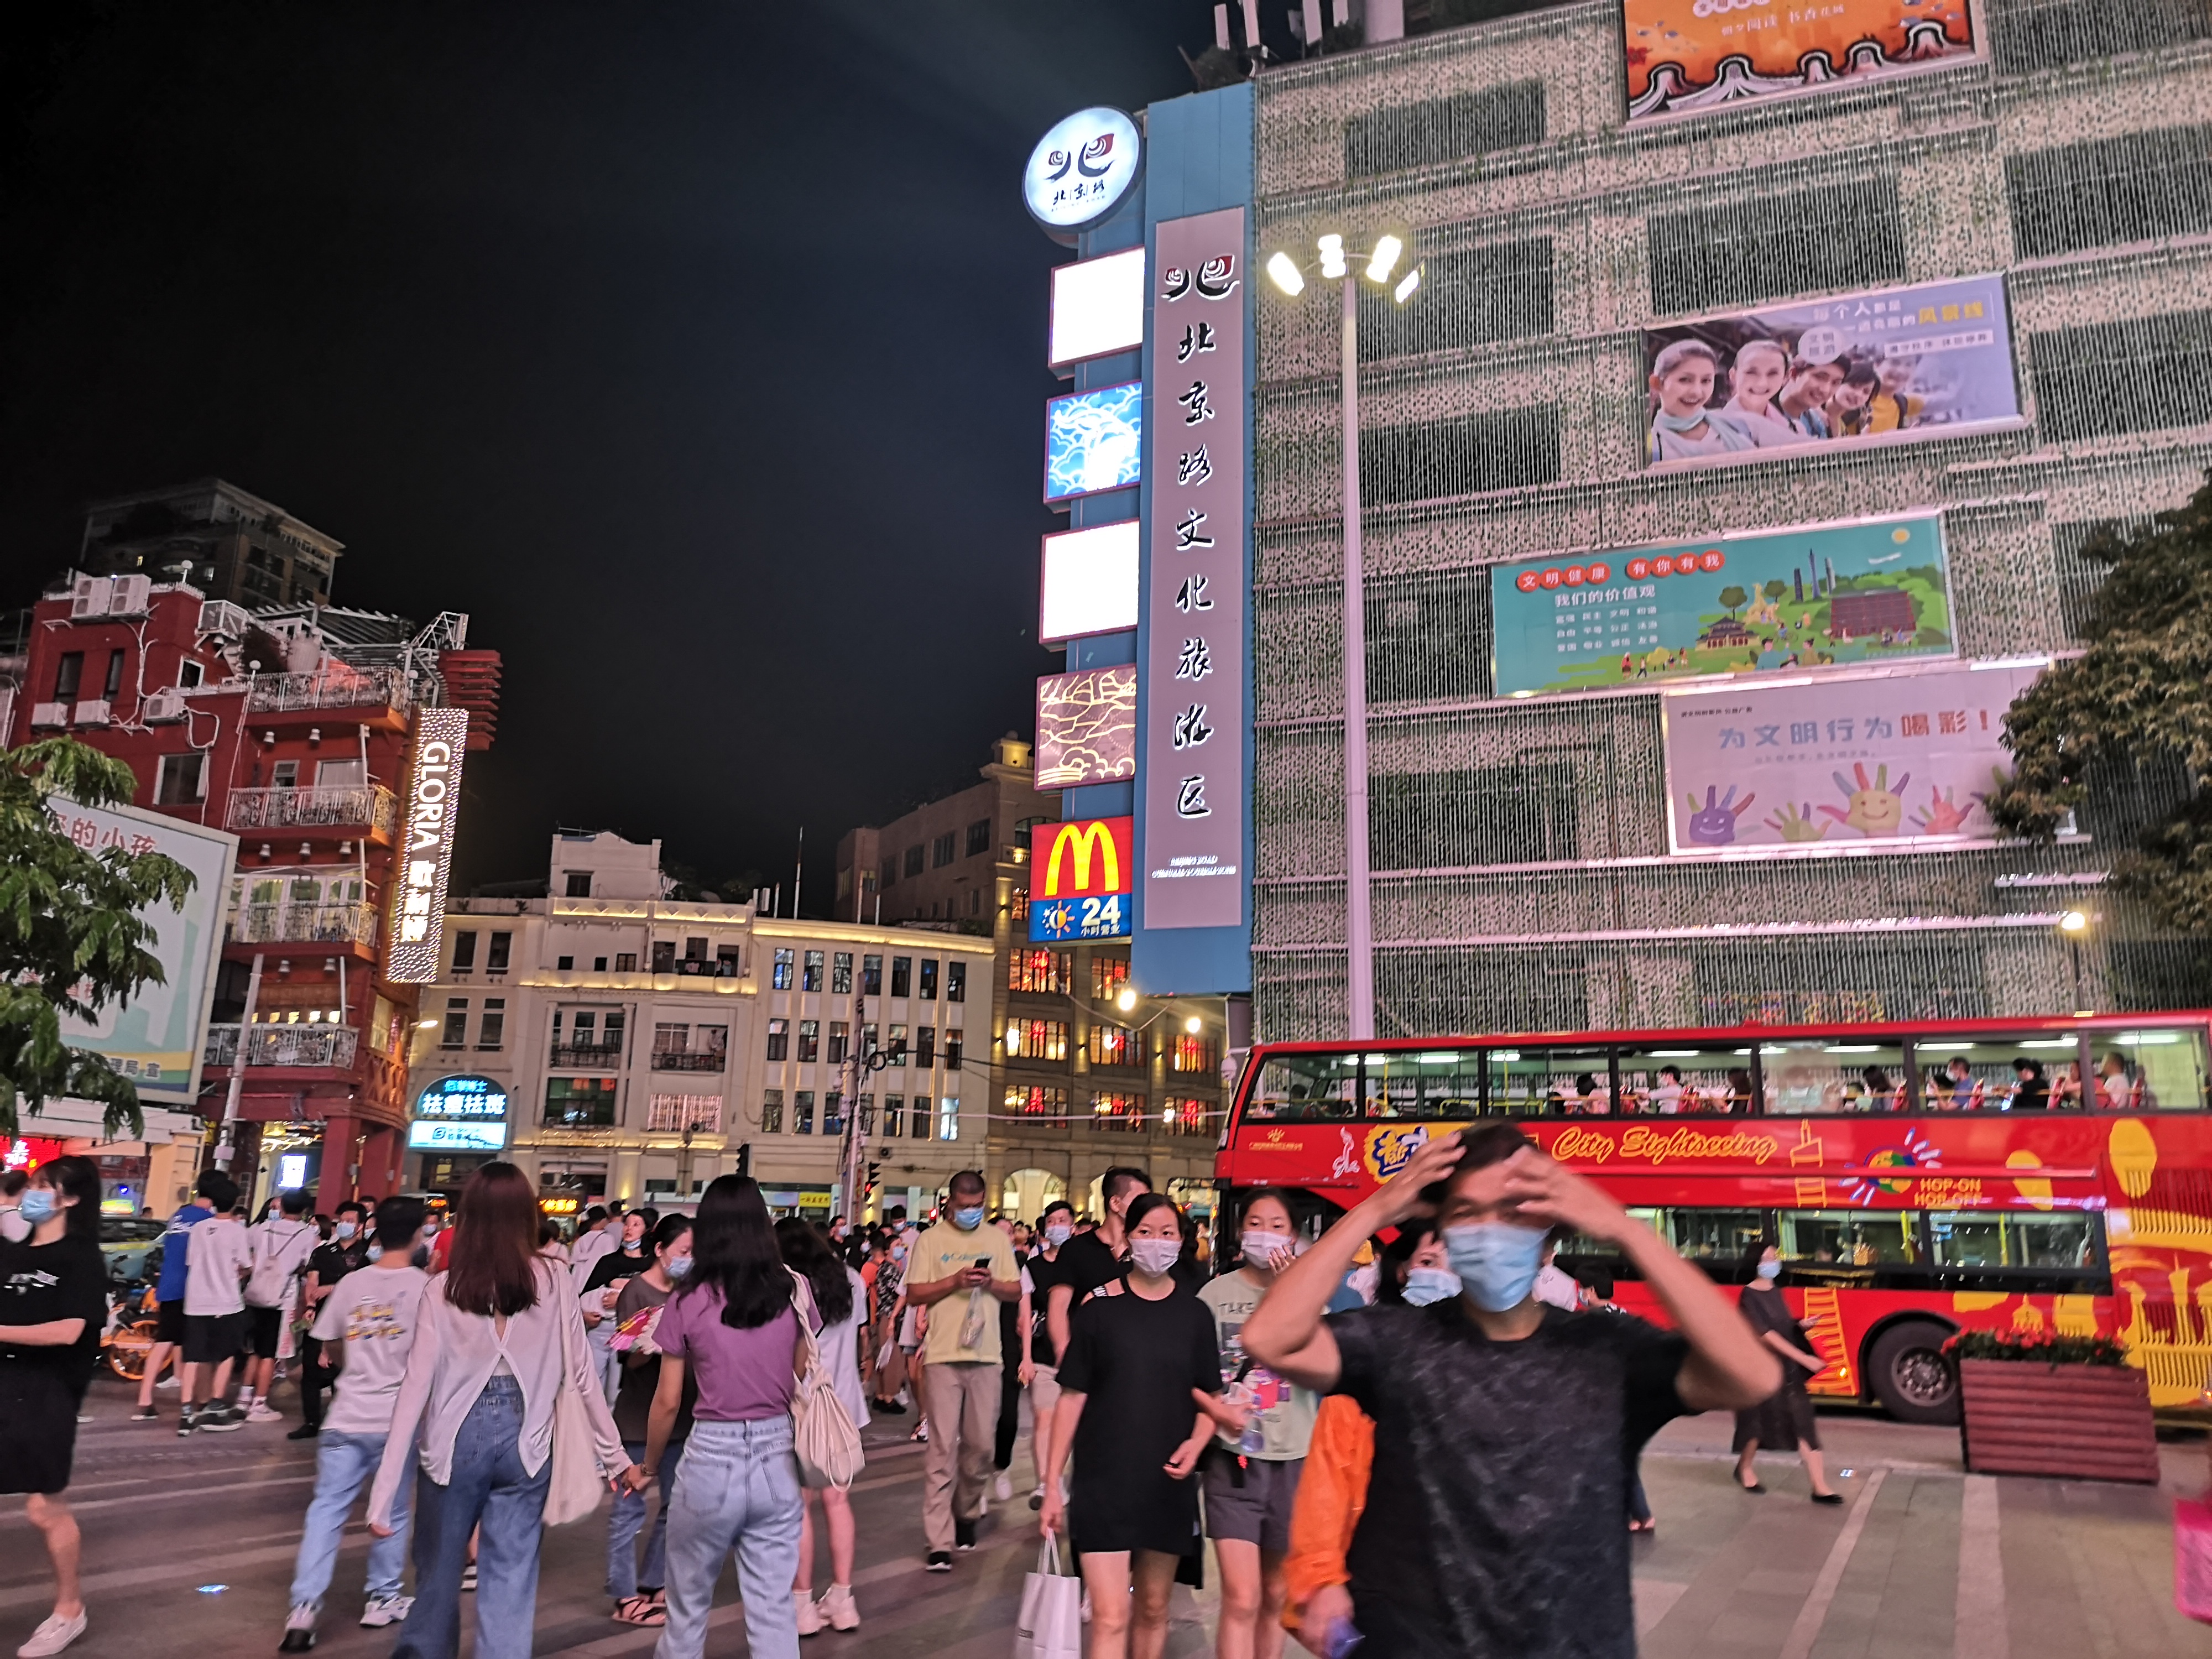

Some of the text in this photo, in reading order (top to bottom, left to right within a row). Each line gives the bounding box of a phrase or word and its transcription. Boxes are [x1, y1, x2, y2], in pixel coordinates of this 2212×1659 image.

[1523, 554, 1719, 587] 文明健康 有你有我
[1554, 584, 1656, 607] 我们的价值观
[411, 741, 451, 851] GLORIA
[1081, 895, 1121, 927] 24
[1080, 922, 1121, 937] 小时营业
[1552, 1125, 1778, 1165] City Sightseeing
[1920, 1178, 1982, 1192] HOP-ON
